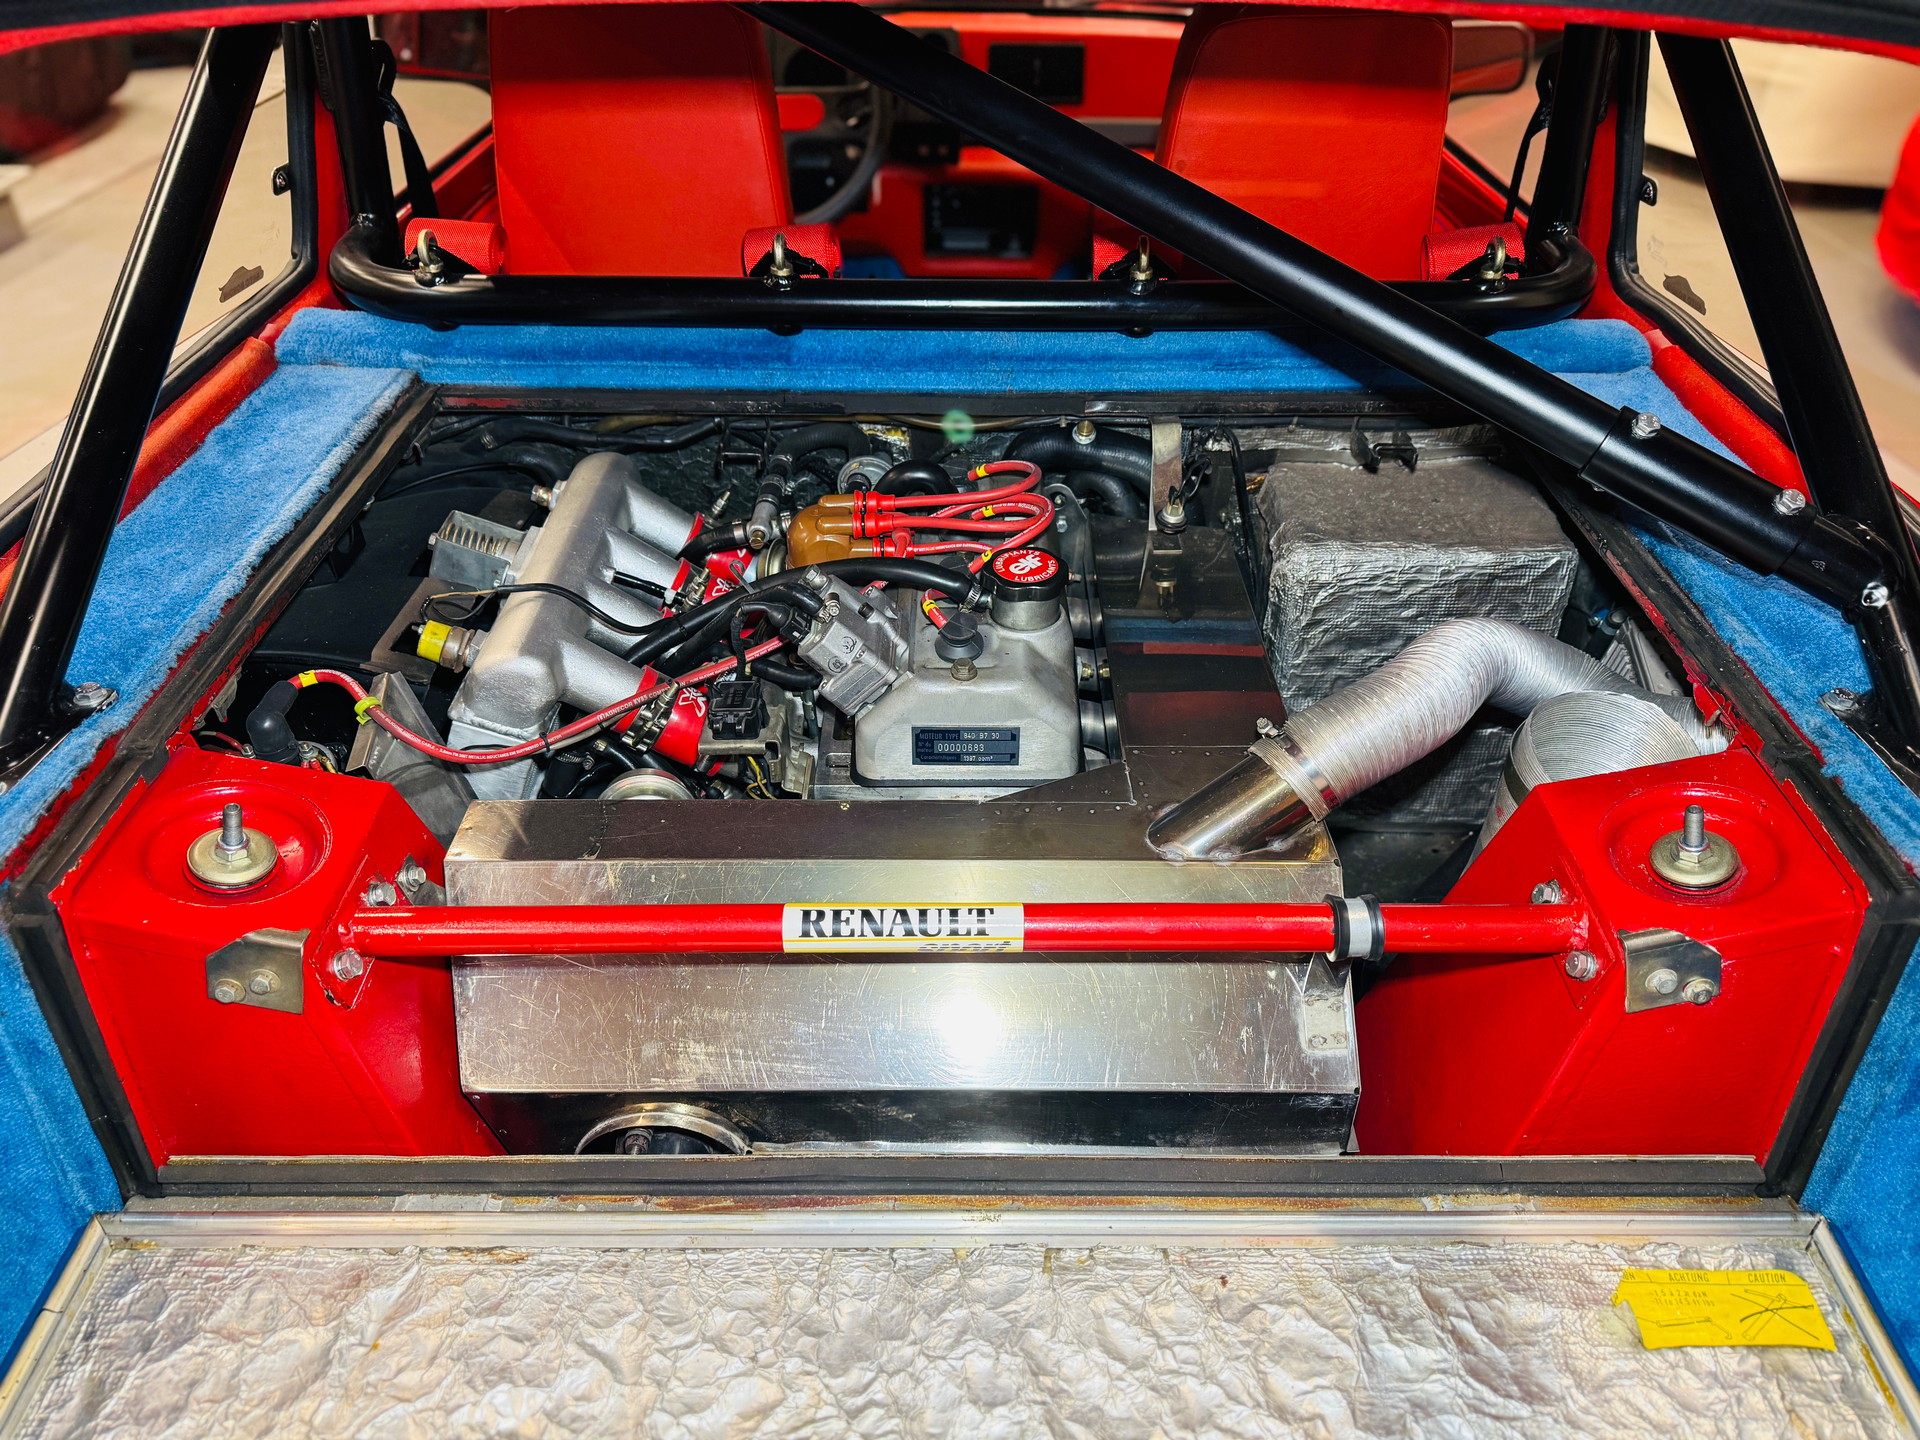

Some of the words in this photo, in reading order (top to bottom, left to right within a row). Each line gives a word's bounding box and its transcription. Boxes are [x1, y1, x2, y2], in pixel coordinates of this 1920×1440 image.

[995, 549, 1041, 573] LUBRIFIANTS
[1008, 554, 1043, 574] elf
[1014, 559, 1057, 582] LUBRICANTS
[596, 702, 634, 721] MAGNECOR
[421, 740, 437, 751] CABLE
[919, 732, 943, 740] MOTEUR
[945, 732, 959, 740] TYPE
[963, 732, 976, 740] 840
[937, 743, 985, 752] 00000683
[798, 908, 995, 938] RENAULT
[1668, 1272, 1710, 1283] ACHTUNG
[1747, 1272, 1787, 1283] CAUTION
